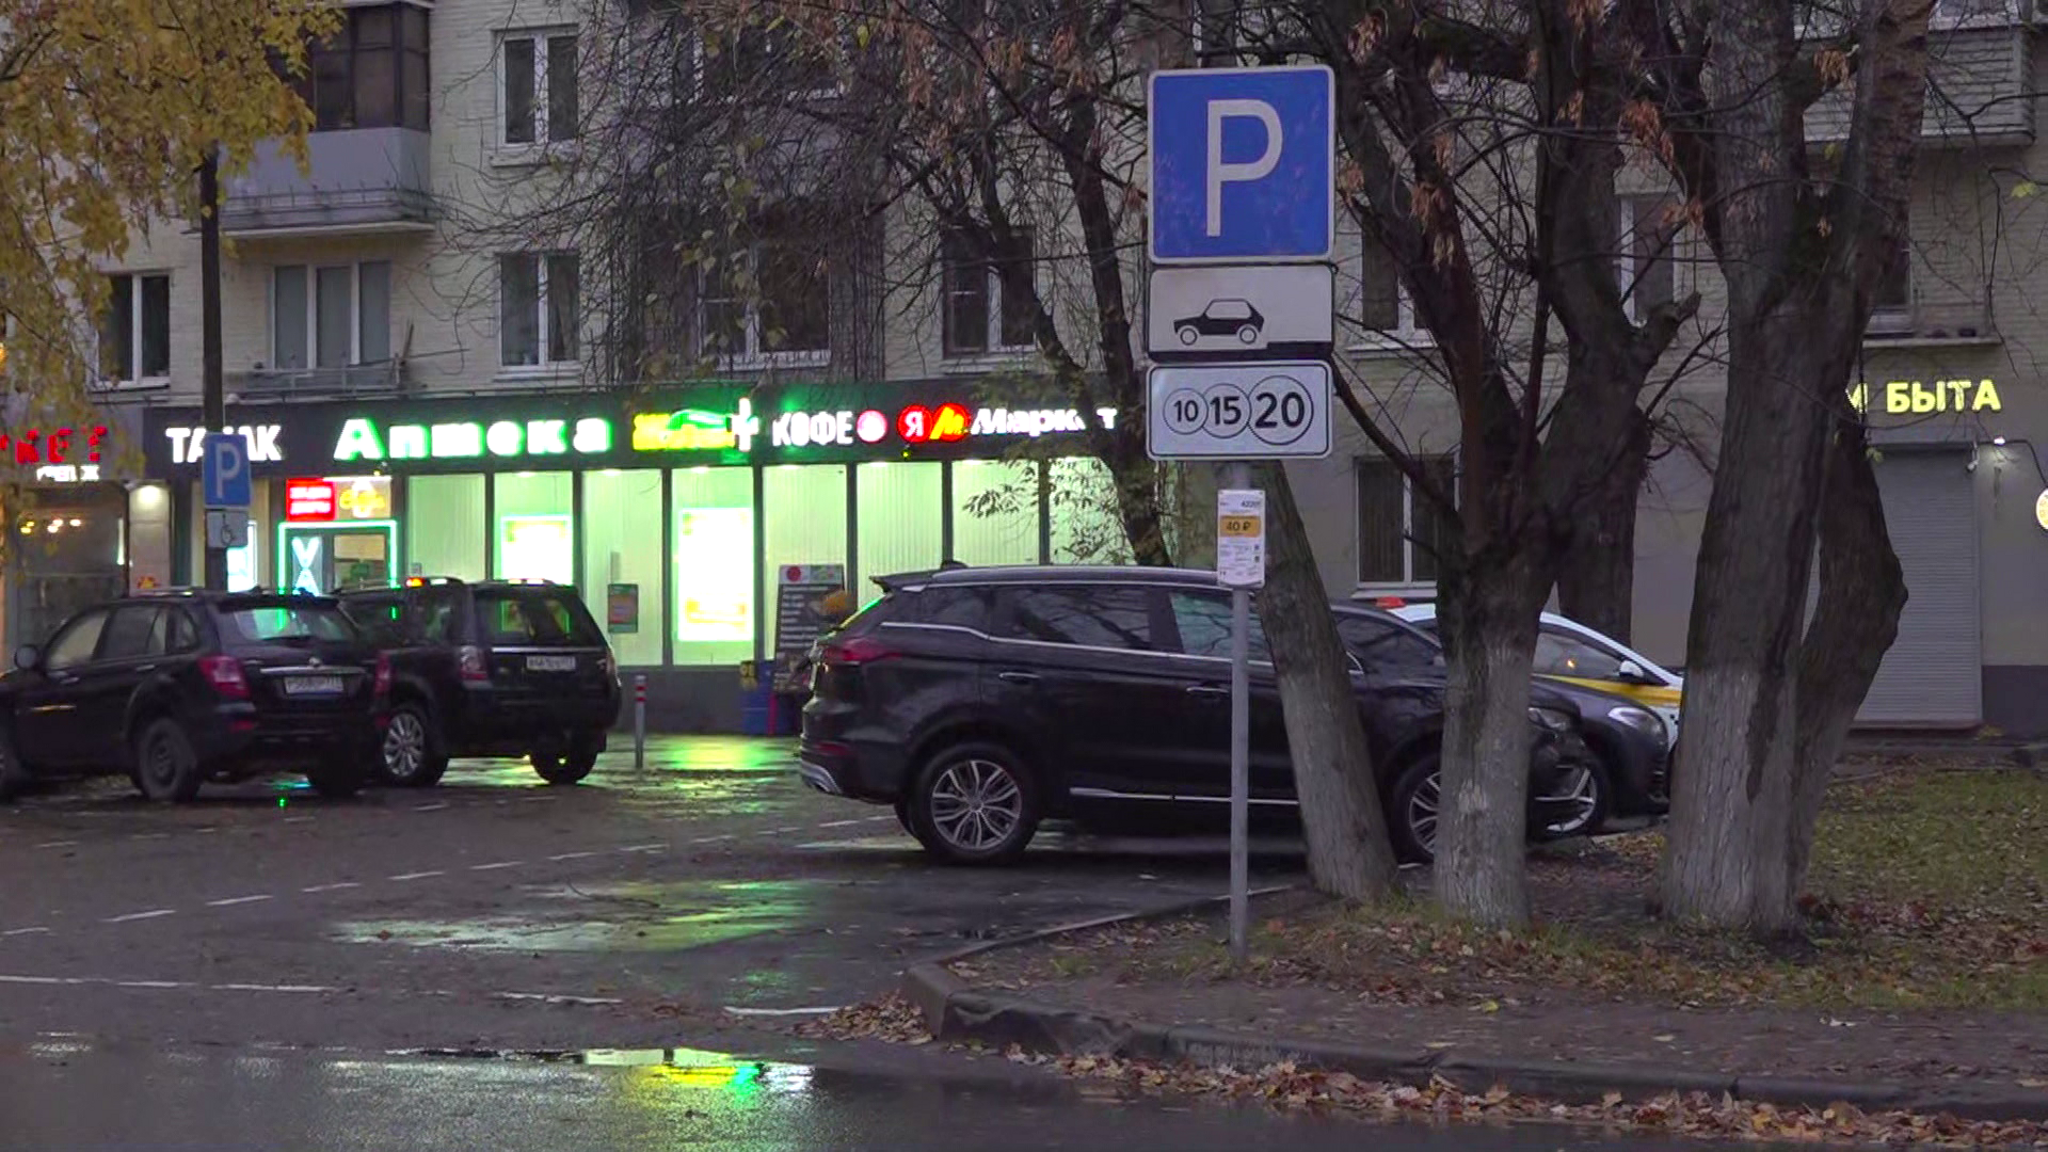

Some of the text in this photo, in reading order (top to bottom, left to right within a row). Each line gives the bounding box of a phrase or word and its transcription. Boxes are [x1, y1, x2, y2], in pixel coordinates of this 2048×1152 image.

[1206, 99, 1283, 237] P
[1173, 392, 1305, 429] 10 15 20
[1886, 379, 2002, 413] БЫТА
[333, 417, 610, 461] Аптека
[772, 409, 853, 446] КОФЕ
[905, 411, 924, 437] Я
[215, 443, 241, 499] P
